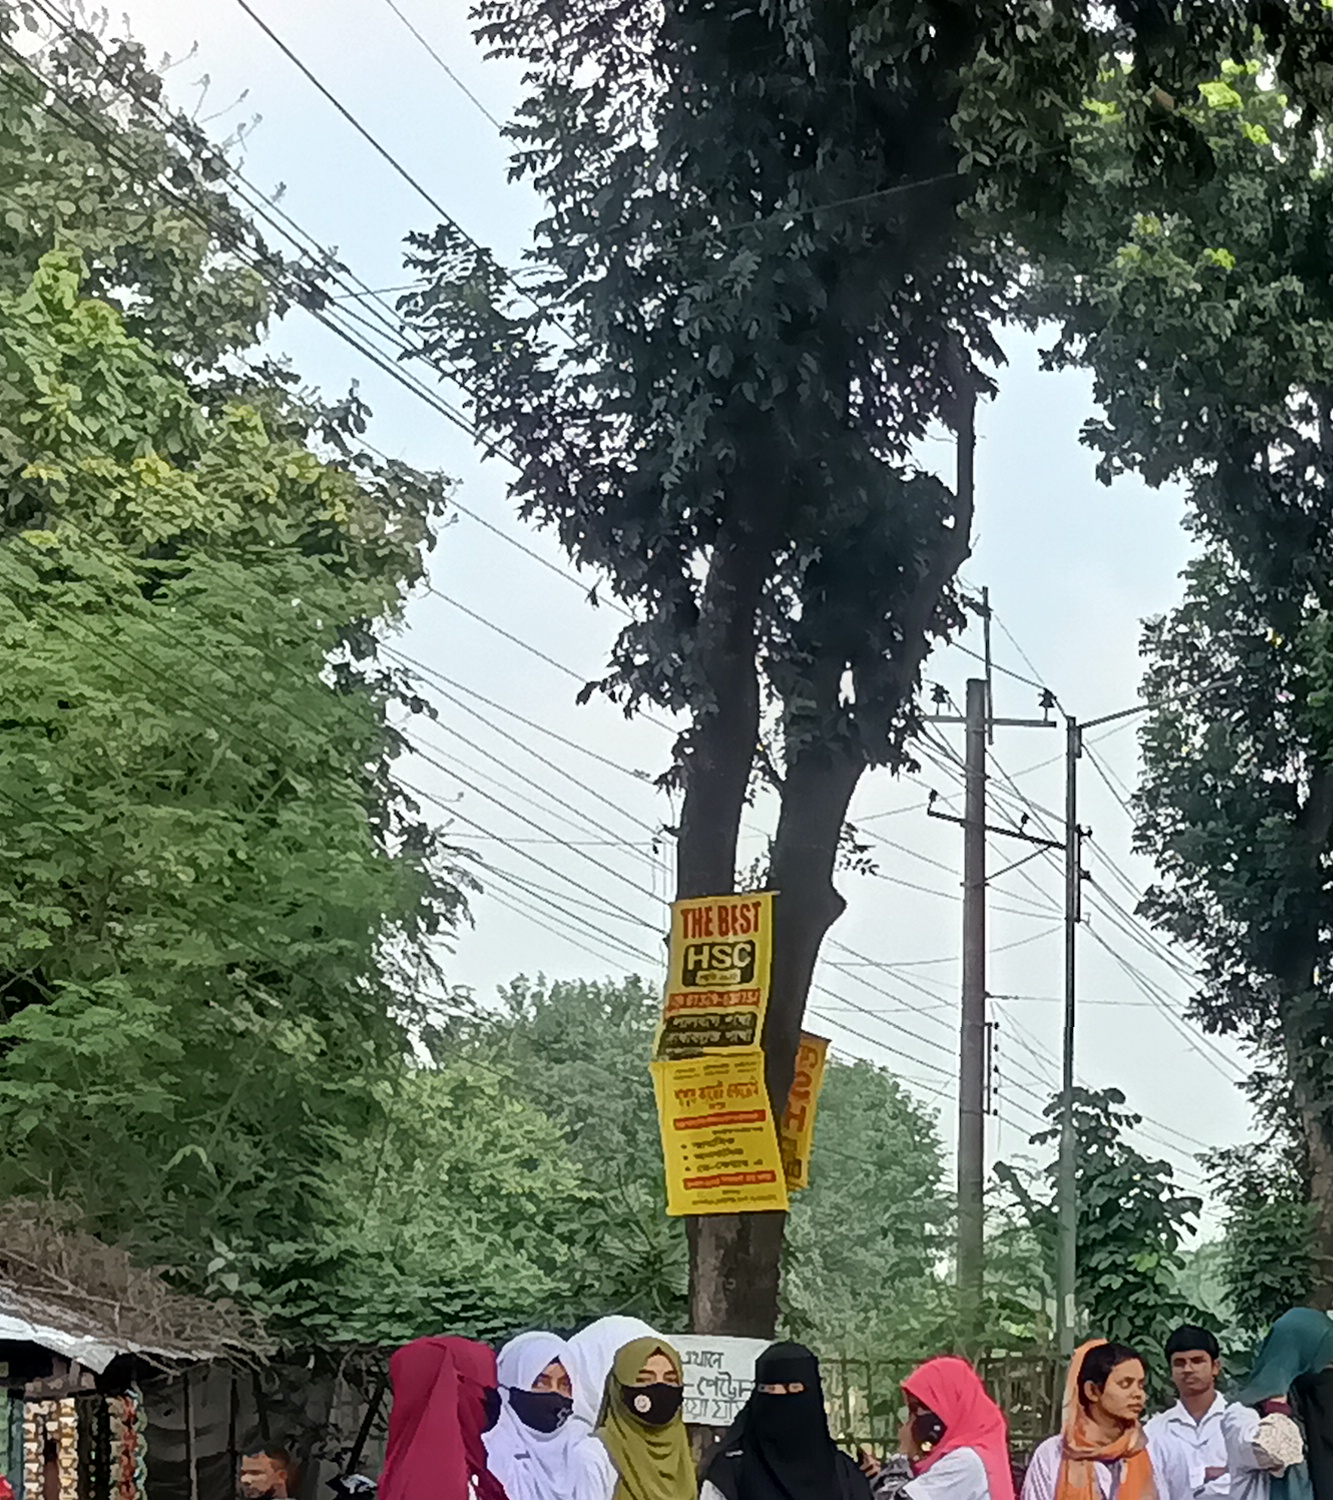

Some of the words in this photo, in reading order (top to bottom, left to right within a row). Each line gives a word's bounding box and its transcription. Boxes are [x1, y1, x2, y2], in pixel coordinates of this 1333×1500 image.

[681, 905, 713, 939] THE
[717, 901, 761, 937] BEST
[687, 943, 752, 970] HSC
